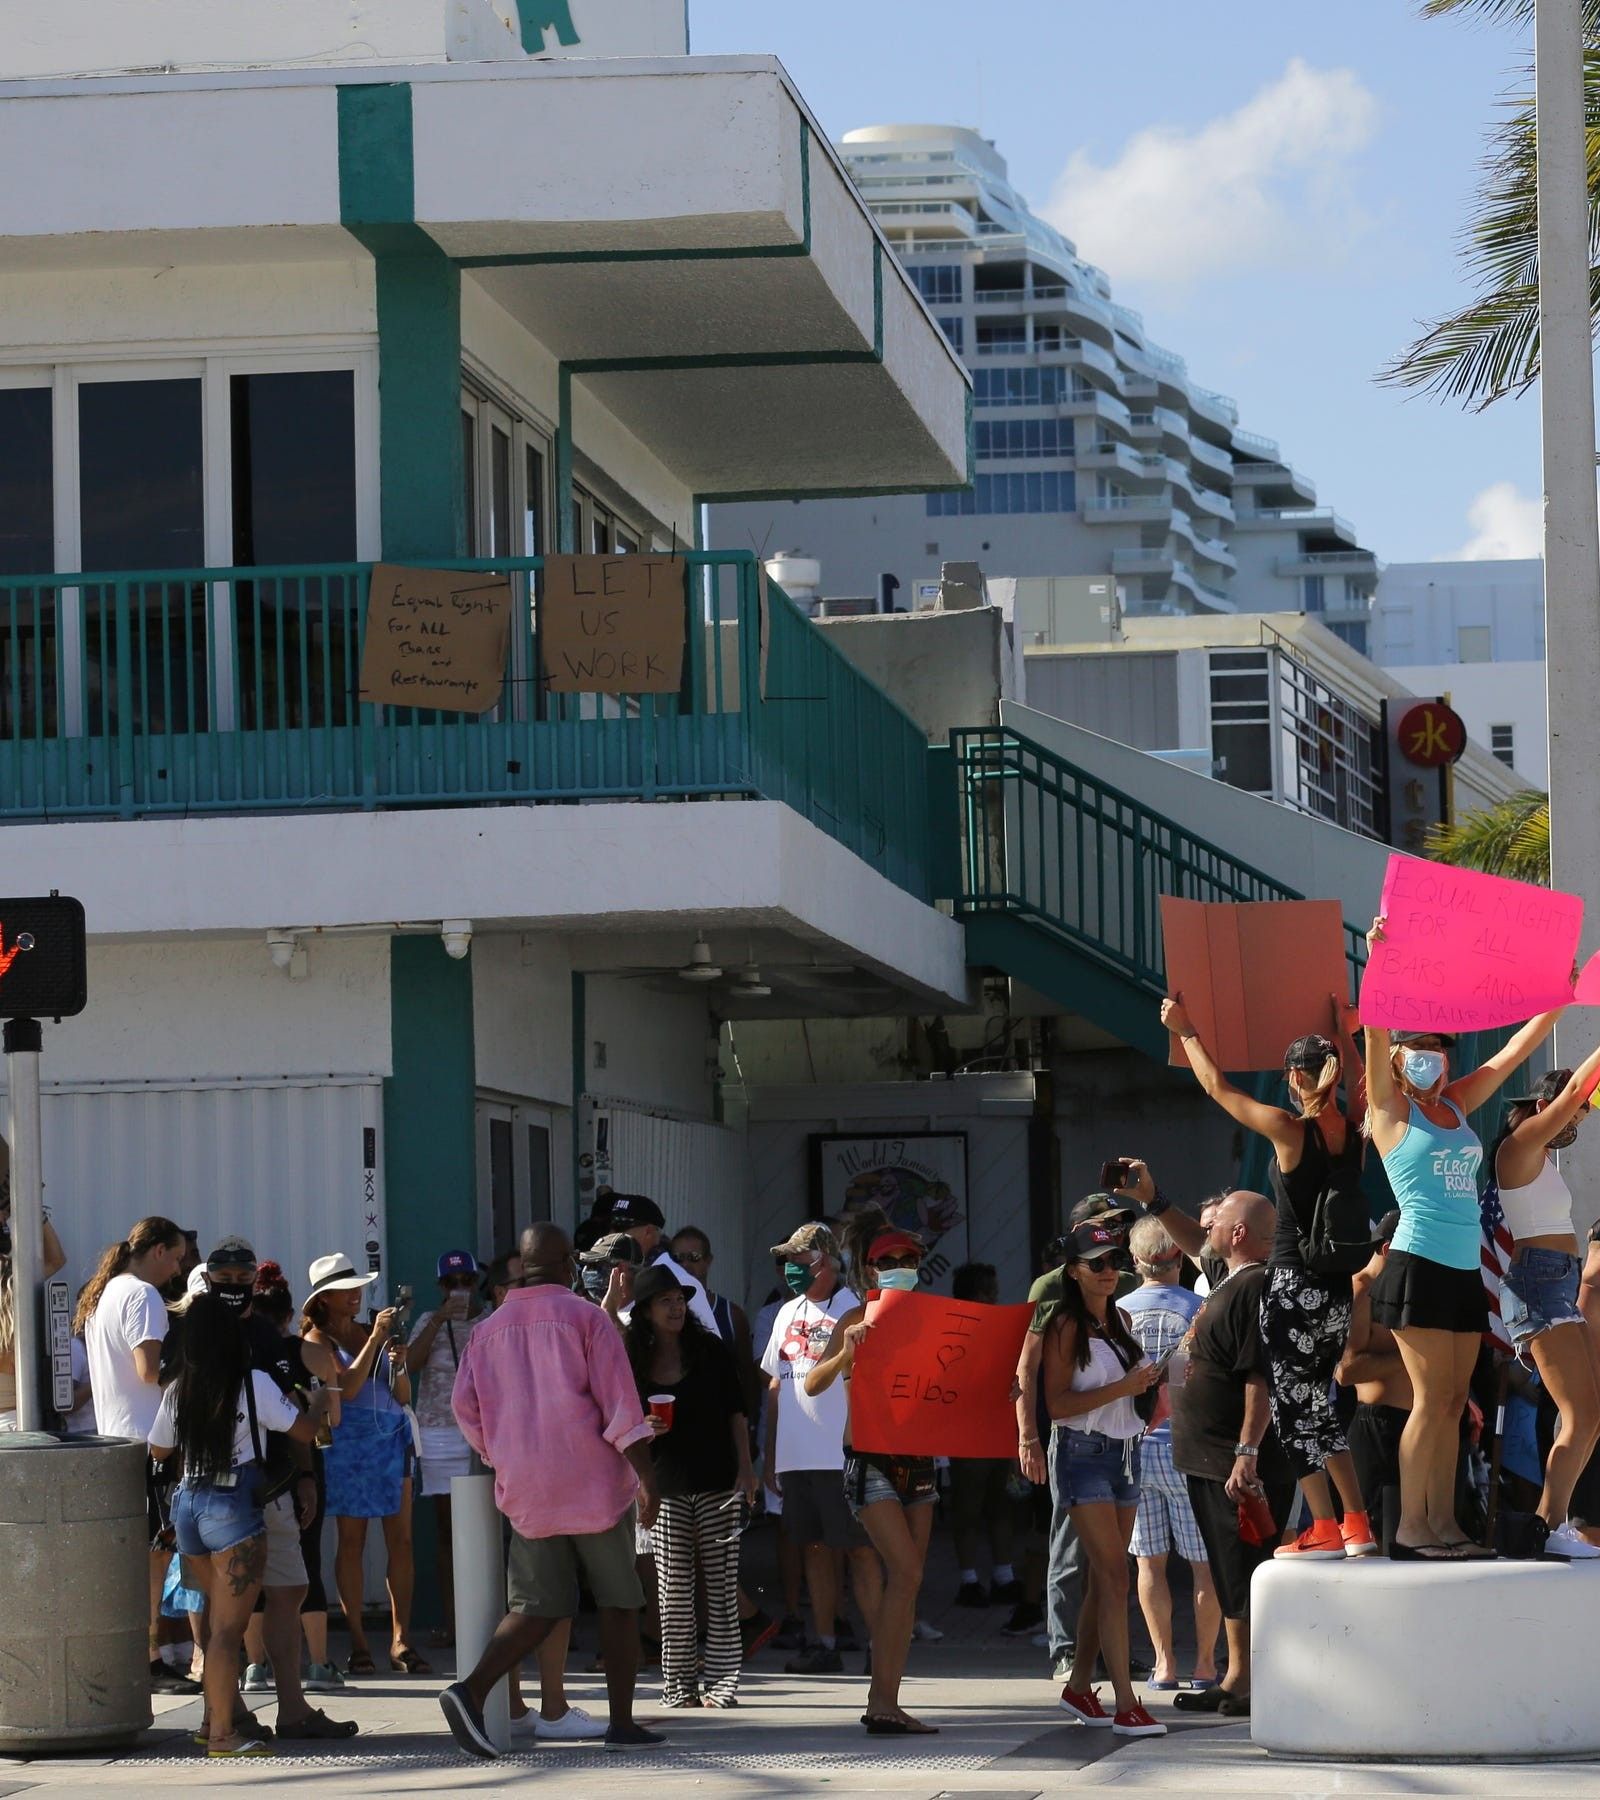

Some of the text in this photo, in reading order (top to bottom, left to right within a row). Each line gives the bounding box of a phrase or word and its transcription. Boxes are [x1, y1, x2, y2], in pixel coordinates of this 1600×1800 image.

[571, 561, 664, 599] LET
[580, 610, 622, 637] US
[563, 648, 666, 680] WORK
[1409, 709, 1452, 759] 水
[1391, 860, 1577, 941] EQUAL RIGHTS
[1407, 912, 1518, 956] FOR ALL
[1382, 948, 1525, 1007] BARS AND
[1433, 1160, 1469, 1176] ELBO
[891, 1373, 959, 1405] Elbo
